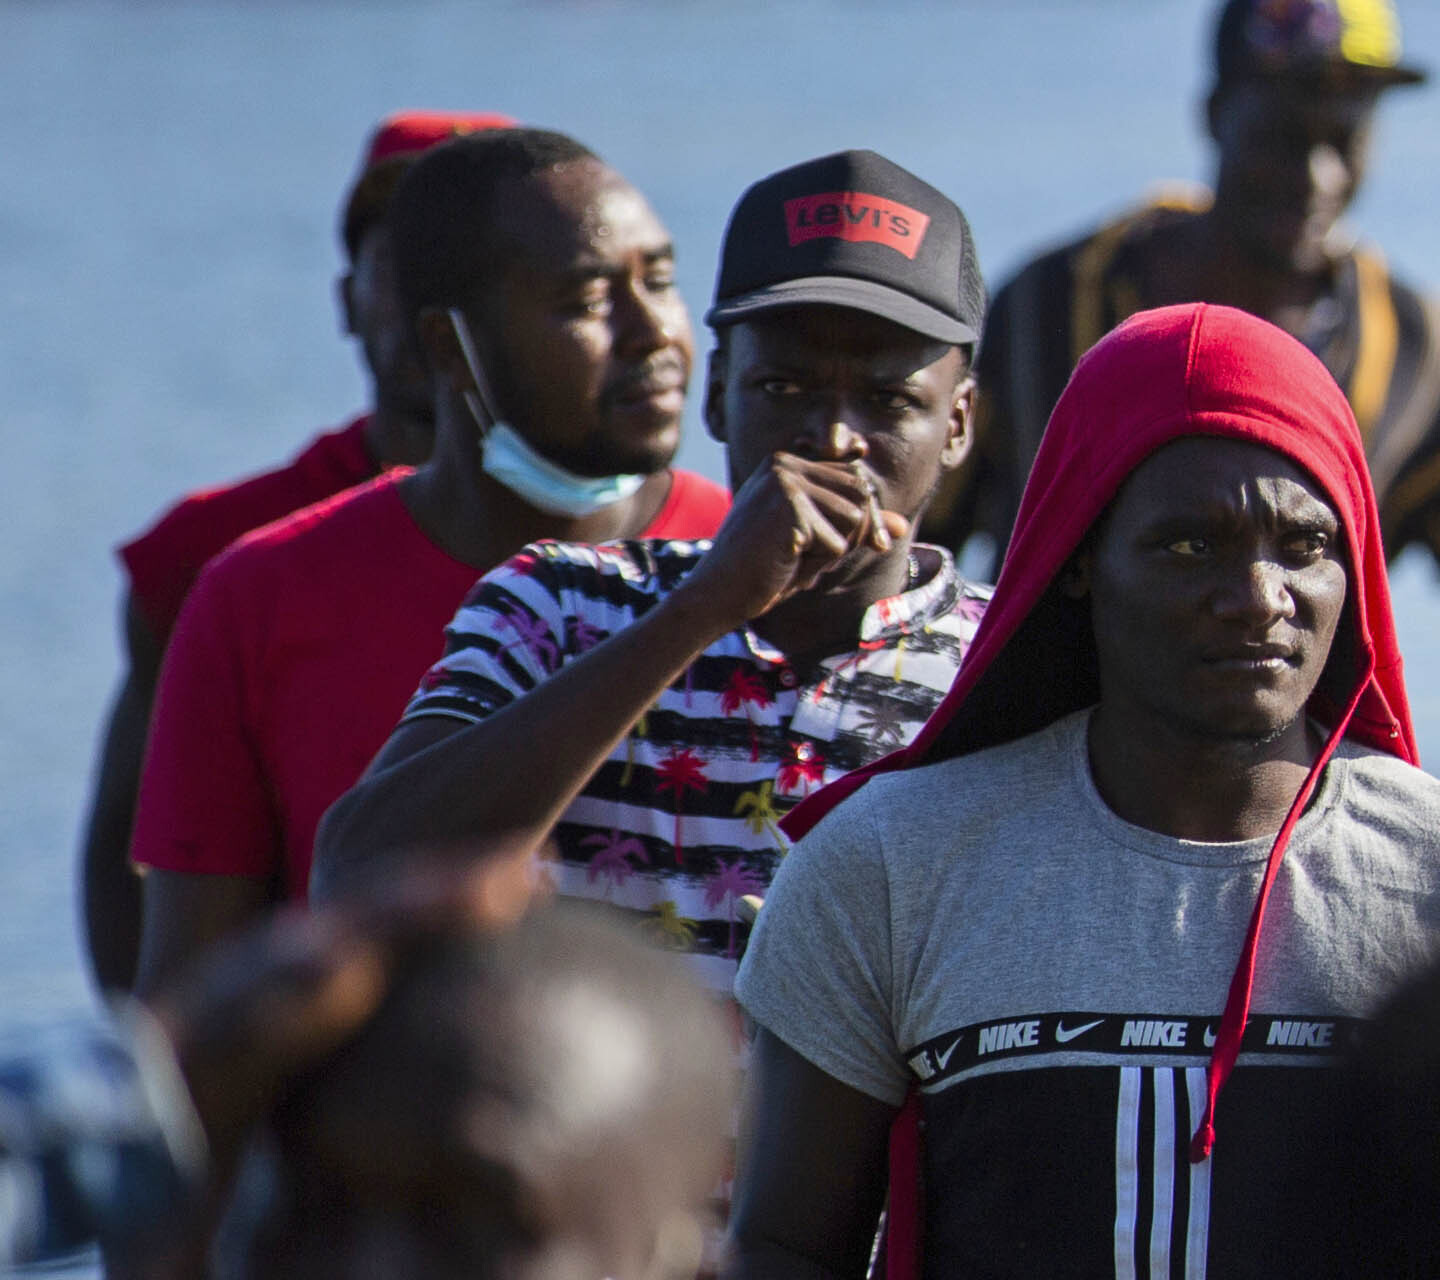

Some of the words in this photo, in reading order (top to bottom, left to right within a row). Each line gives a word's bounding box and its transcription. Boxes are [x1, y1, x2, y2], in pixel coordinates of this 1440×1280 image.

[978, 1020, 1040, 1056] NIKE
[1120, 1021, 1187, 1047] NIKE
[1266, 1021, 1335, 1047] NIKE
